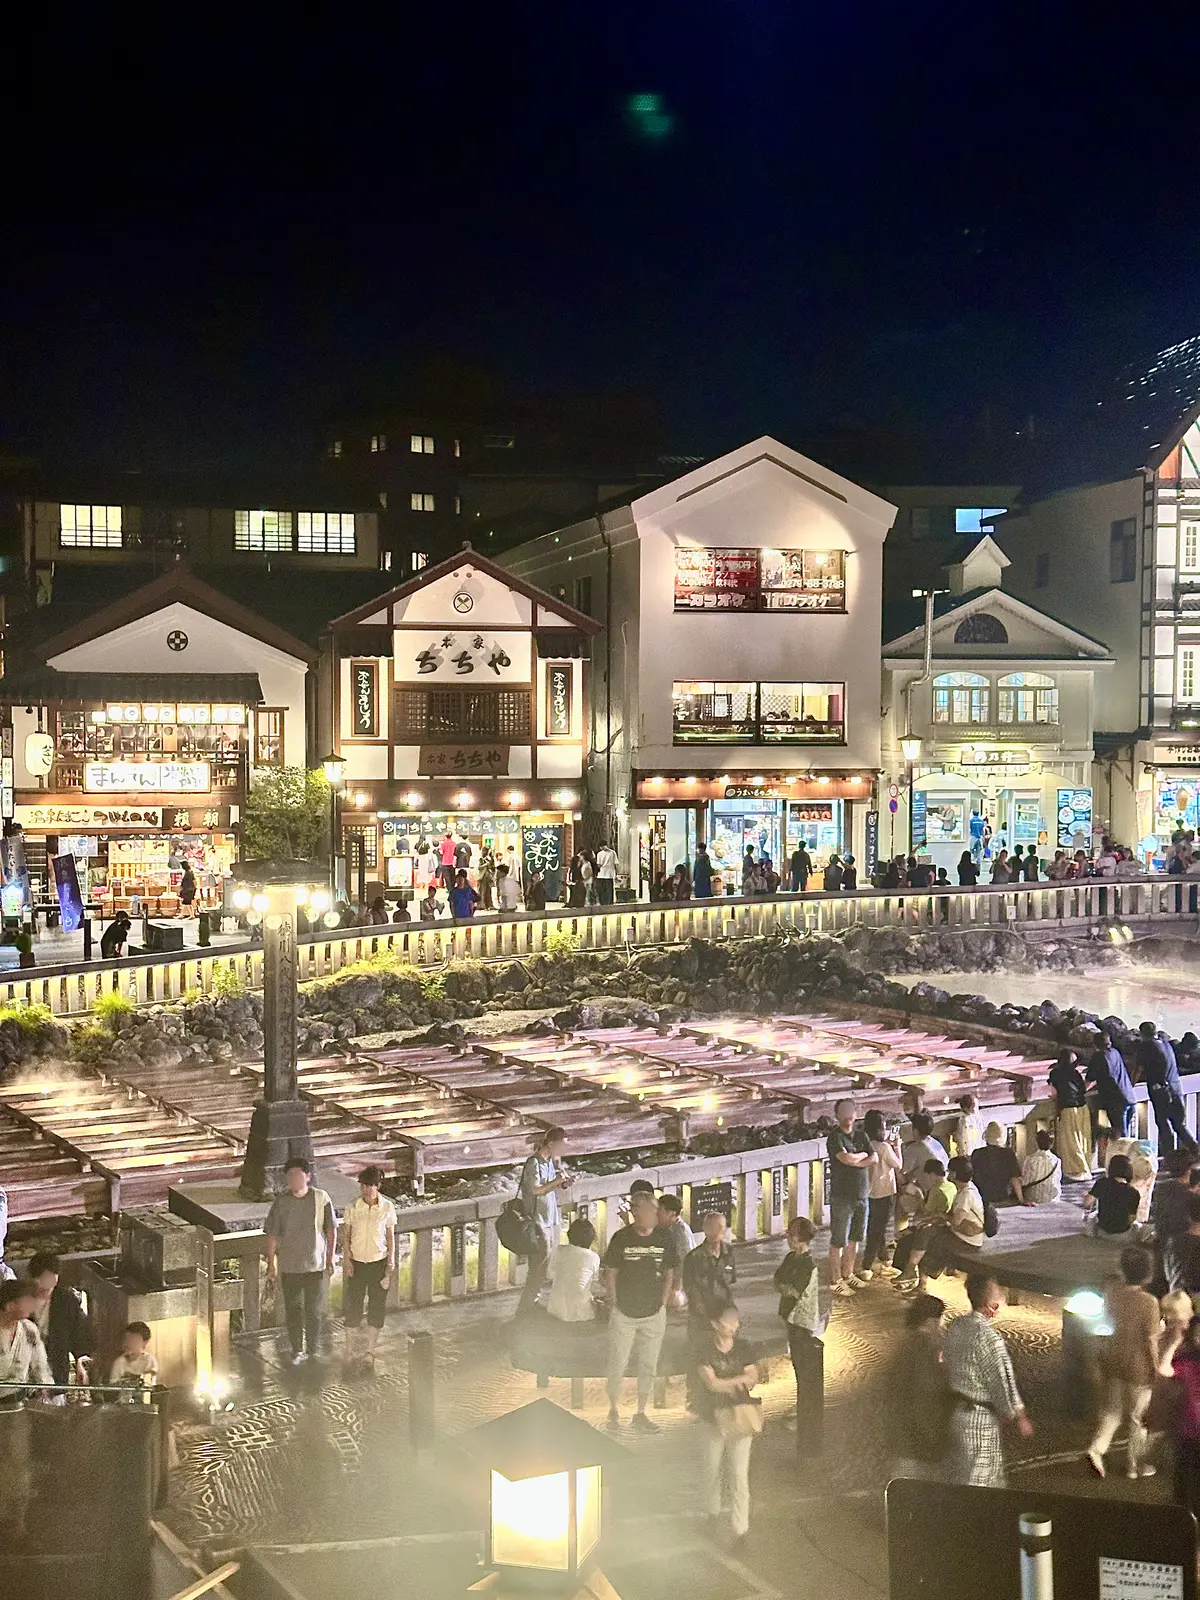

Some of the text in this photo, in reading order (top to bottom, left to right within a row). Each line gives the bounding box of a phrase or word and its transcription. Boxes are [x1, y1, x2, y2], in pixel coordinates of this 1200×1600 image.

[441, 635, 484, 649] 本家
[415, 650, 511, 675] ちちや
[449, 750, 502, 768] ちちや
